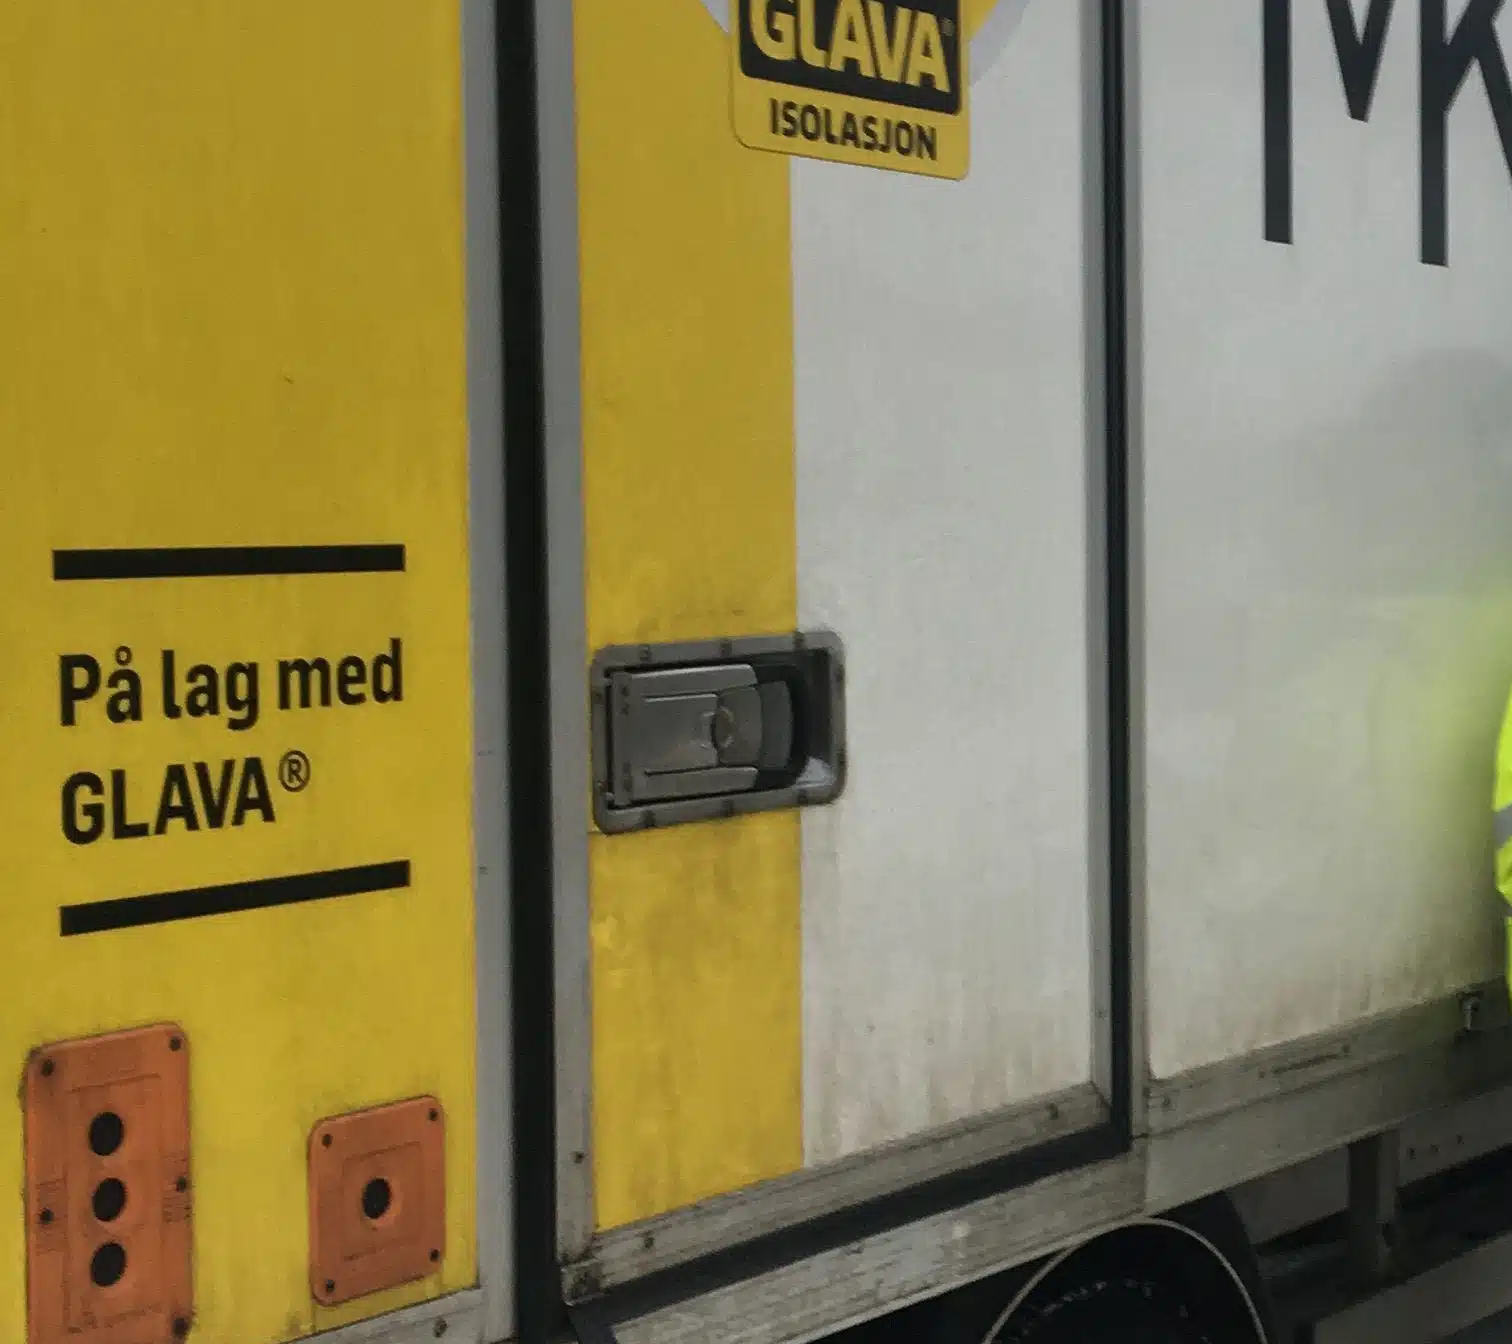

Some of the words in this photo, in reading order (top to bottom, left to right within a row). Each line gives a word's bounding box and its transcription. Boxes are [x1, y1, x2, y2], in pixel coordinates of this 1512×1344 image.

[769, 97, 938, 163] ISOLASJON
[59, 646, 143, 727] På
[161, 649, 260, 731] lag
[279, 638, 404, 712] med
[60, 749, 312, 844] GLAVA®
